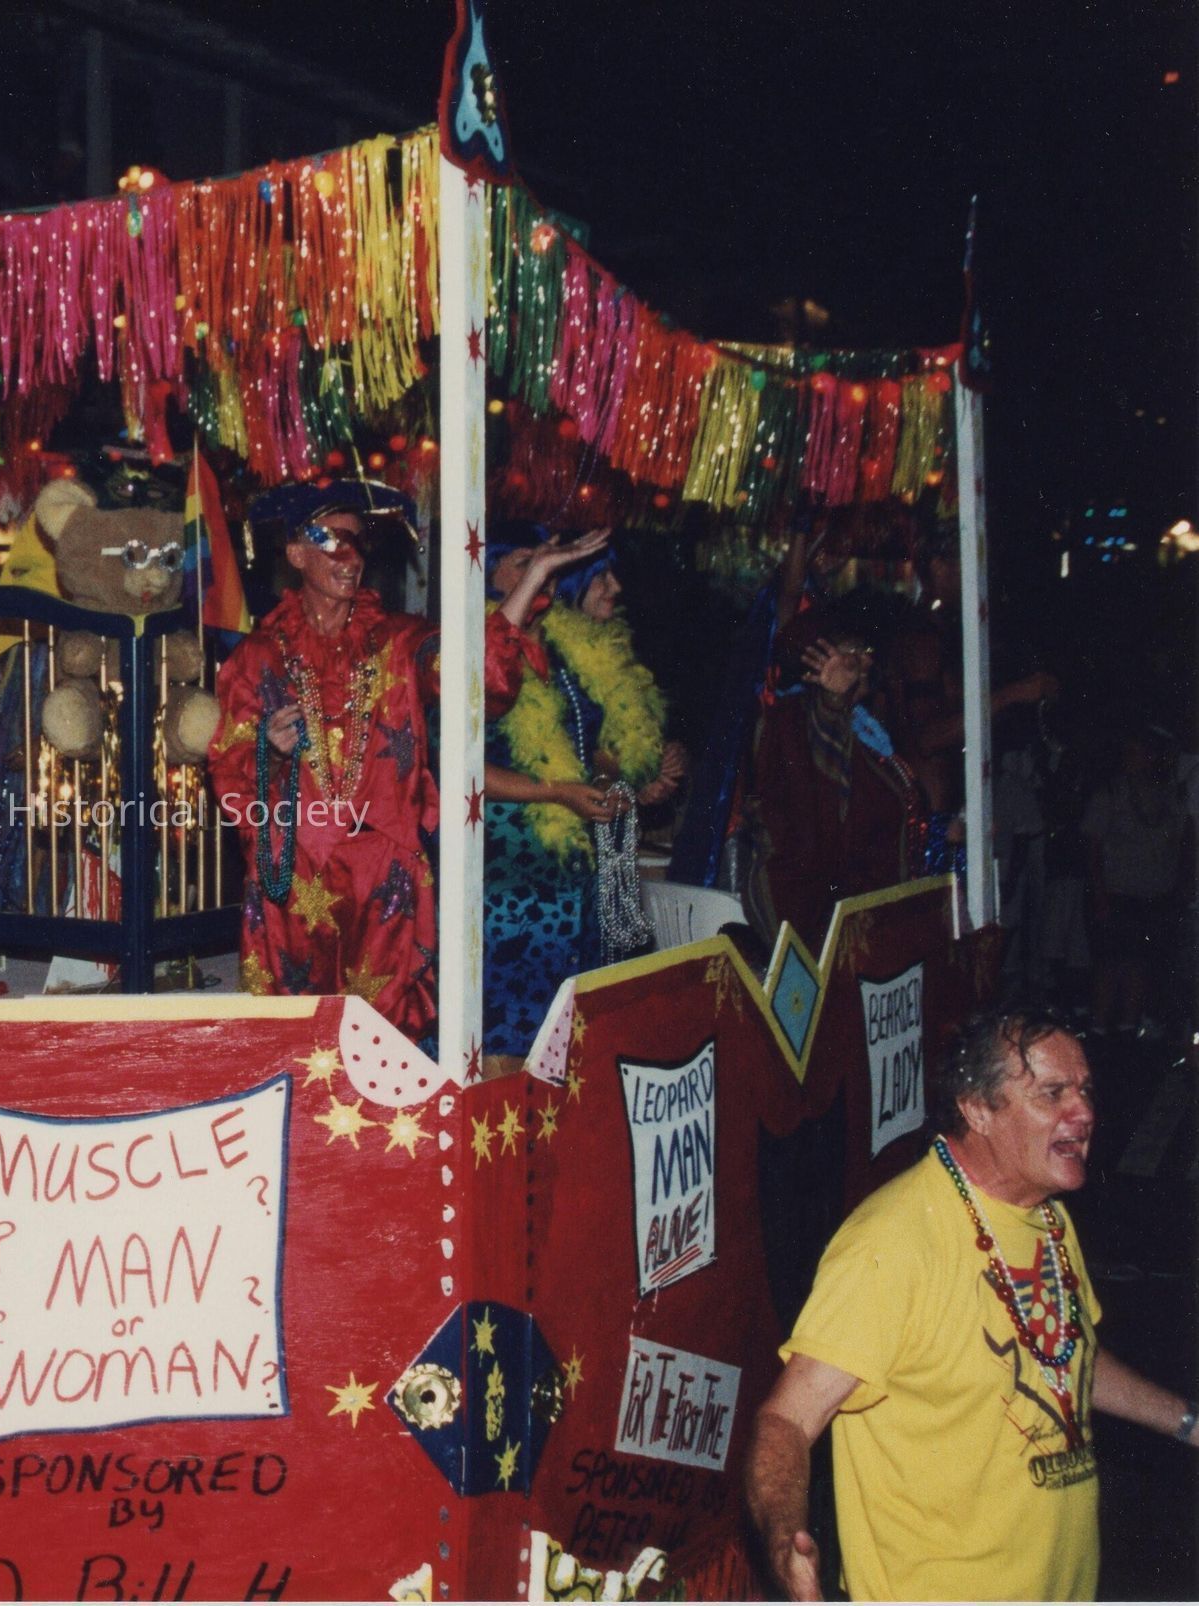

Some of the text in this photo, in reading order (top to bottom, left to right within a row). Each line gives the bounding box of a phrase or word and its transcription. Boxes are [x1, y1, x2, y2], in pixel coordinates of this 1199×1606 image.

[868, 978, 921, 1046] BEARDED
[632, 1057, 714, 1126] LEOPARD
[877, 1037, 922, 1130] LADY
[651, 1110, 714, 1206] MAN
[45, 1225, 223, 1311] MAN
[111, 1315, 145, 1338] or
[620, 1350, 654, 1449] FOR
[648, 1352, 677, 1445] THE
